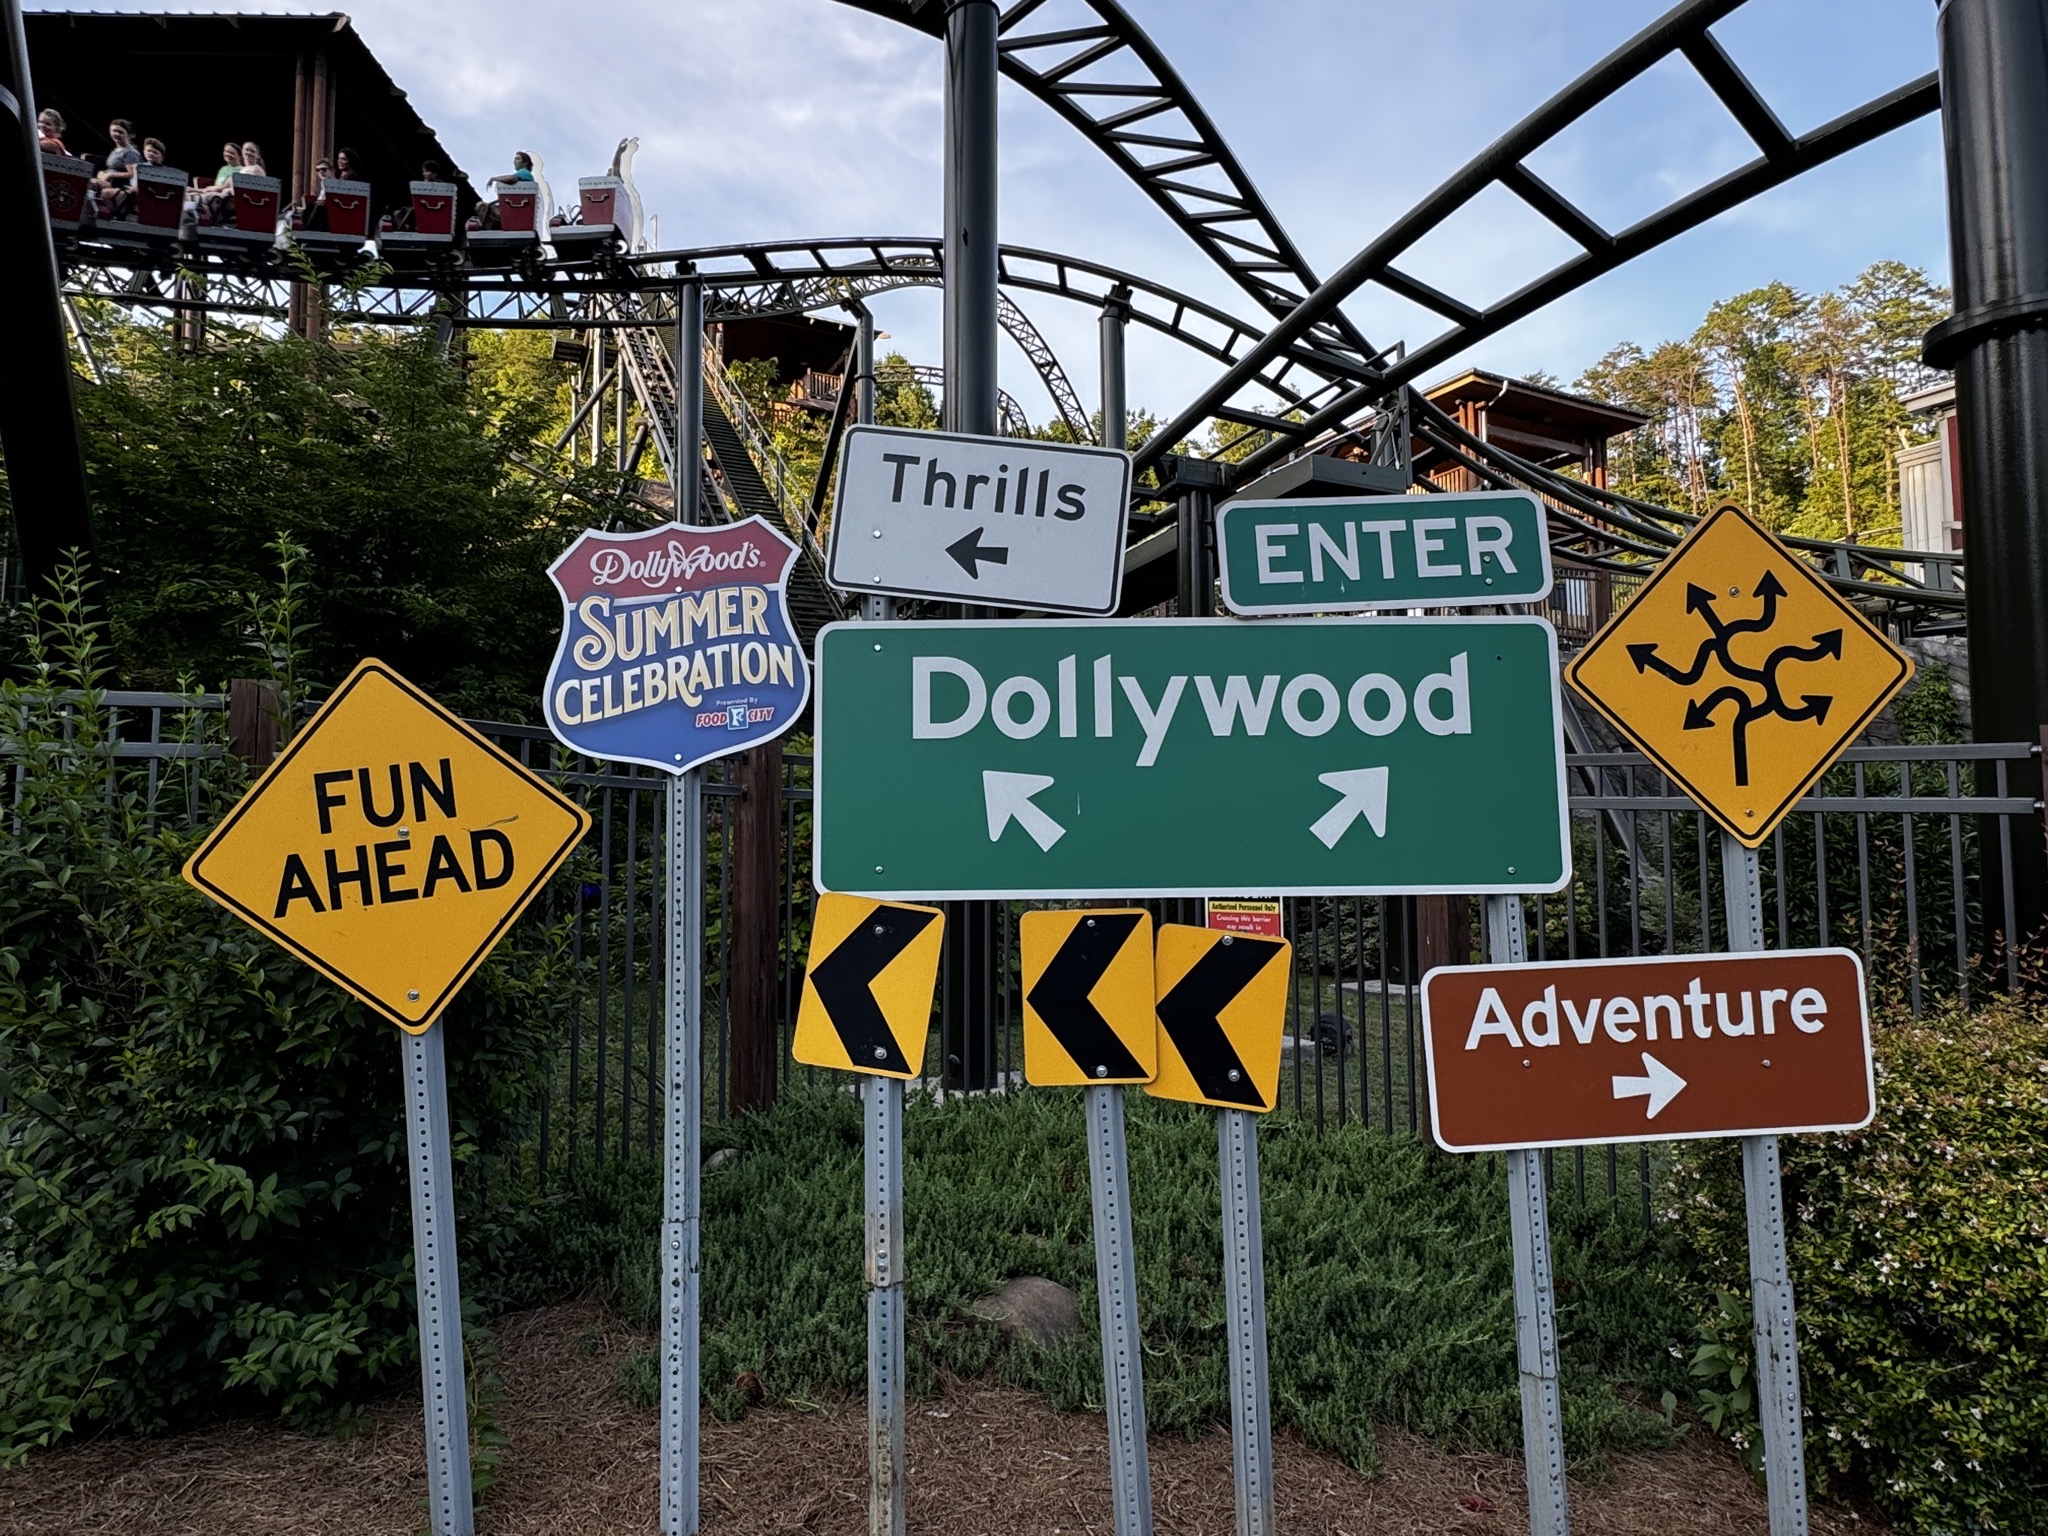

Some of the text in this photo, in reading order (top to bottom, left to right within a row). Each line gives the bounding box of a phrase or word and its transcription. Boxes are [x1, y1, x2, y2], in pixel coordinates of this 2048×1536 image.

[881, 452, 1087, 521] Thrills
[1254, 515, 1519, 584] ENTER
[573, 586, 771, 671] SUMMER
[555, 641, 795, 725] CELEBRATION
[696, 712, 728, 728] FOOD
[748, 707, 774, 722] CITY
[716, 697, 748, 706] Presented
[912, 651, 1472, 767] Dollywood
[313, 757, 458, 835] FUN
[273, 828, 515, 919] AHEAD
[1238, 903, 1263, 911] Personnel
[1264, 904, 1276, 913] Only
[1253, 915, 1272, 923] barrier
[1464, 976, 1829, 1051] Adventure
